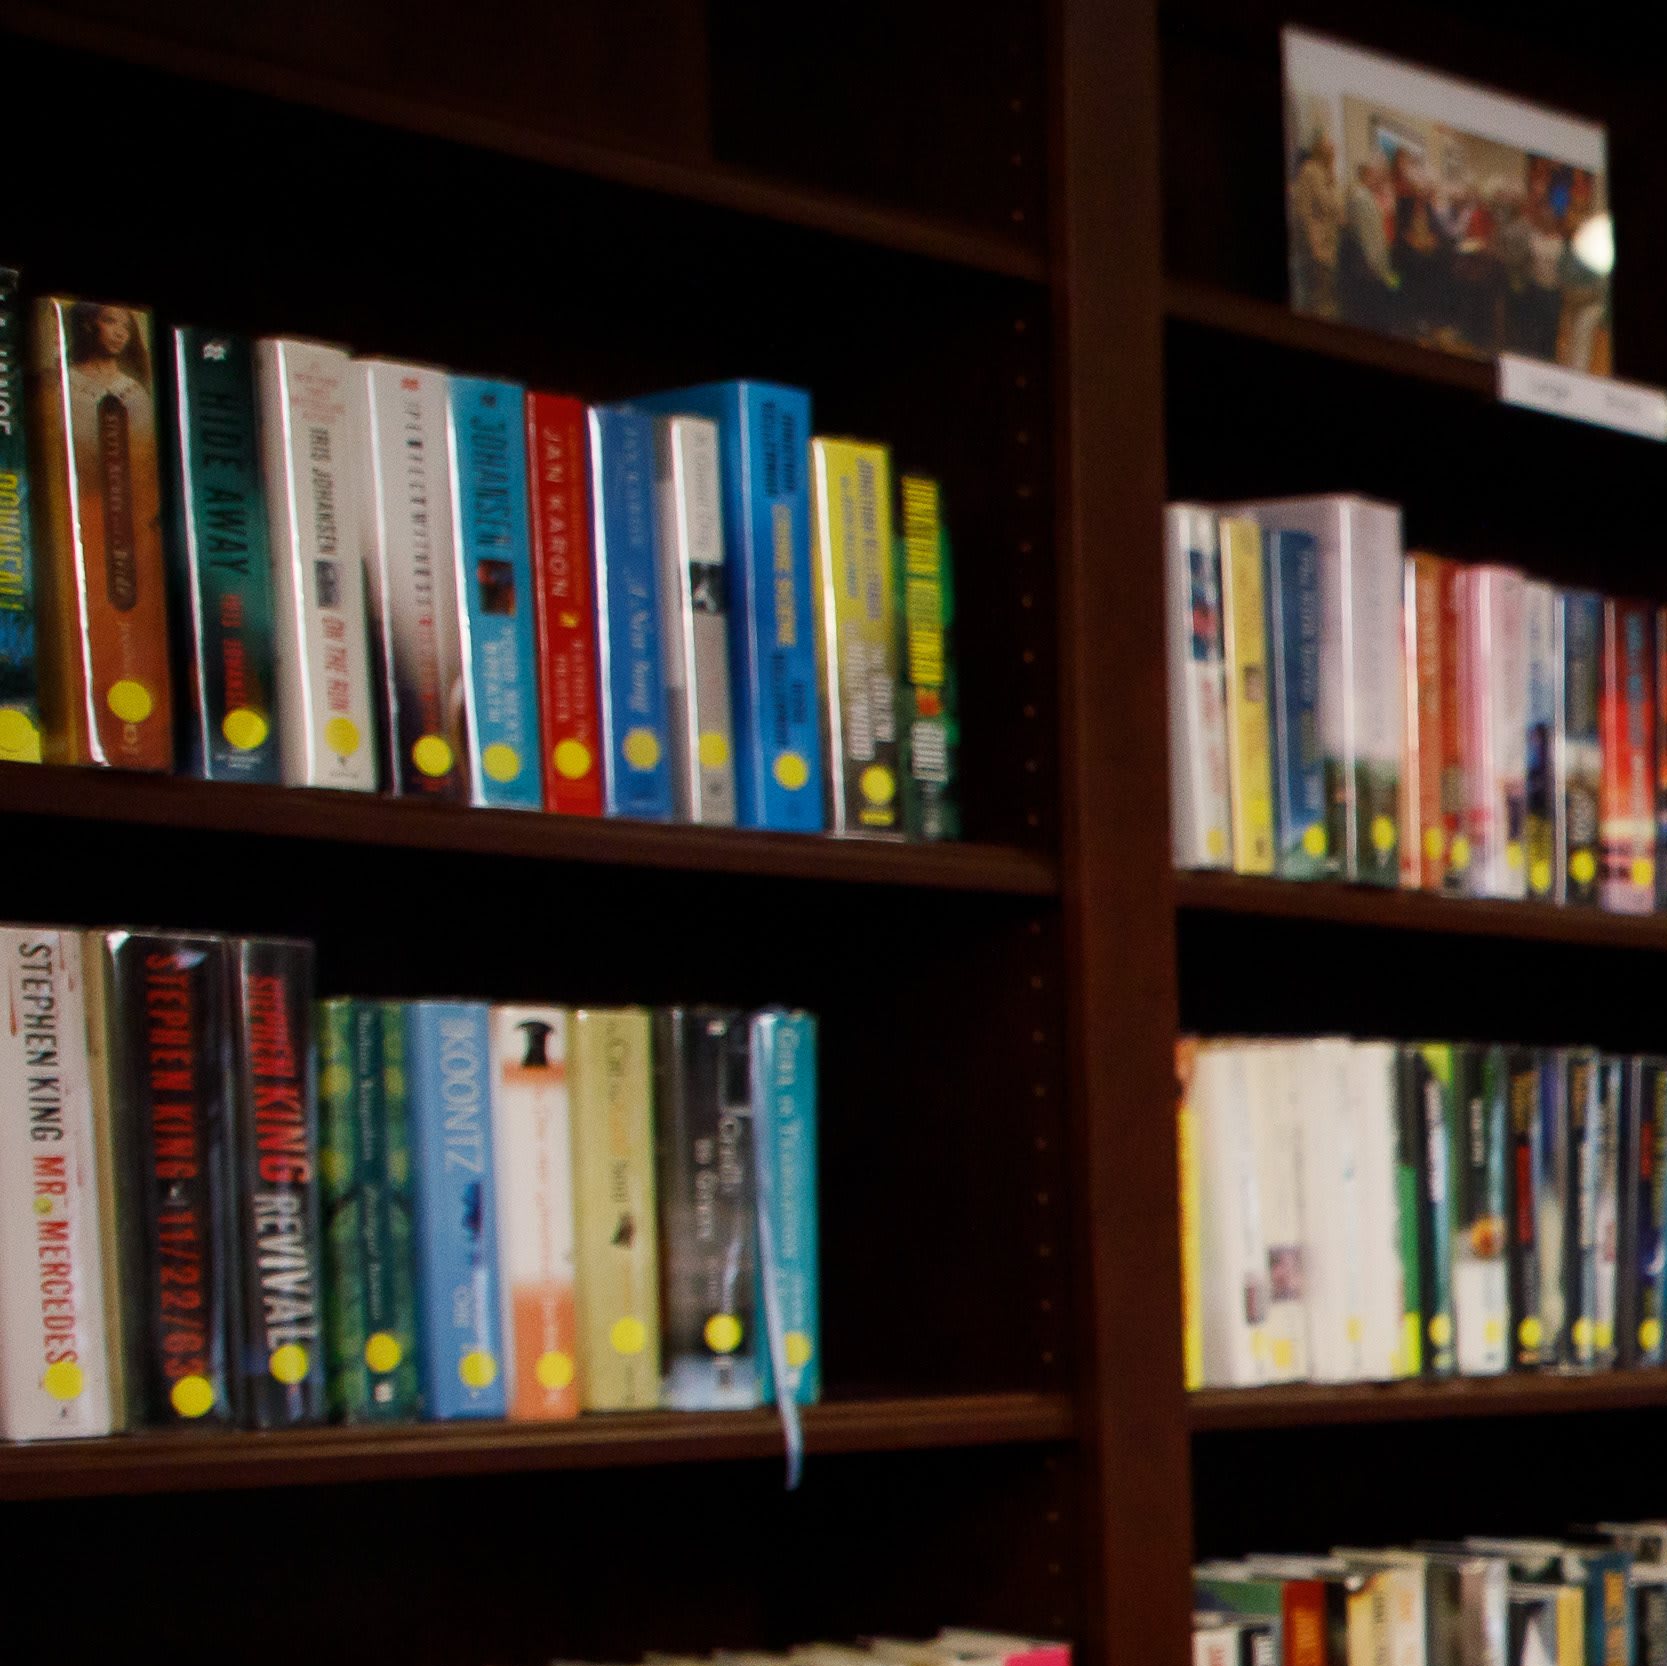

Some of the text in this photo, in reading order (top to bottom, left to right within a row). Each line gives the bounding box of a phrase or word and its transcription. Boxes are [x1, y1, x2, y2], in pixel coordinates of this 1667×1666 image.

[203, 394, 249, 577] HIDE AWAY
[312, 425, 336, 555] IRIS JOHANSEN
[472, 416, 511, 550] JOHANSEN
[545, 430, 567, 597] JAN KARON
[224, 634, 245, 708] JOHANSE
[20, 943, 59, 1068] STEPHEN
[250, 974, 311, 1185] STEPHEN KING
[30, 1077, 63, 1143] KING
[148, 953, 207, 1378] STEPHEN KING 11/22/63
[441, 1016, 485, 1175] KOONTZ
[39, 1220, 78, 1365] MERCEDES
[257, 1192, 321, 1349] REVIVAL
